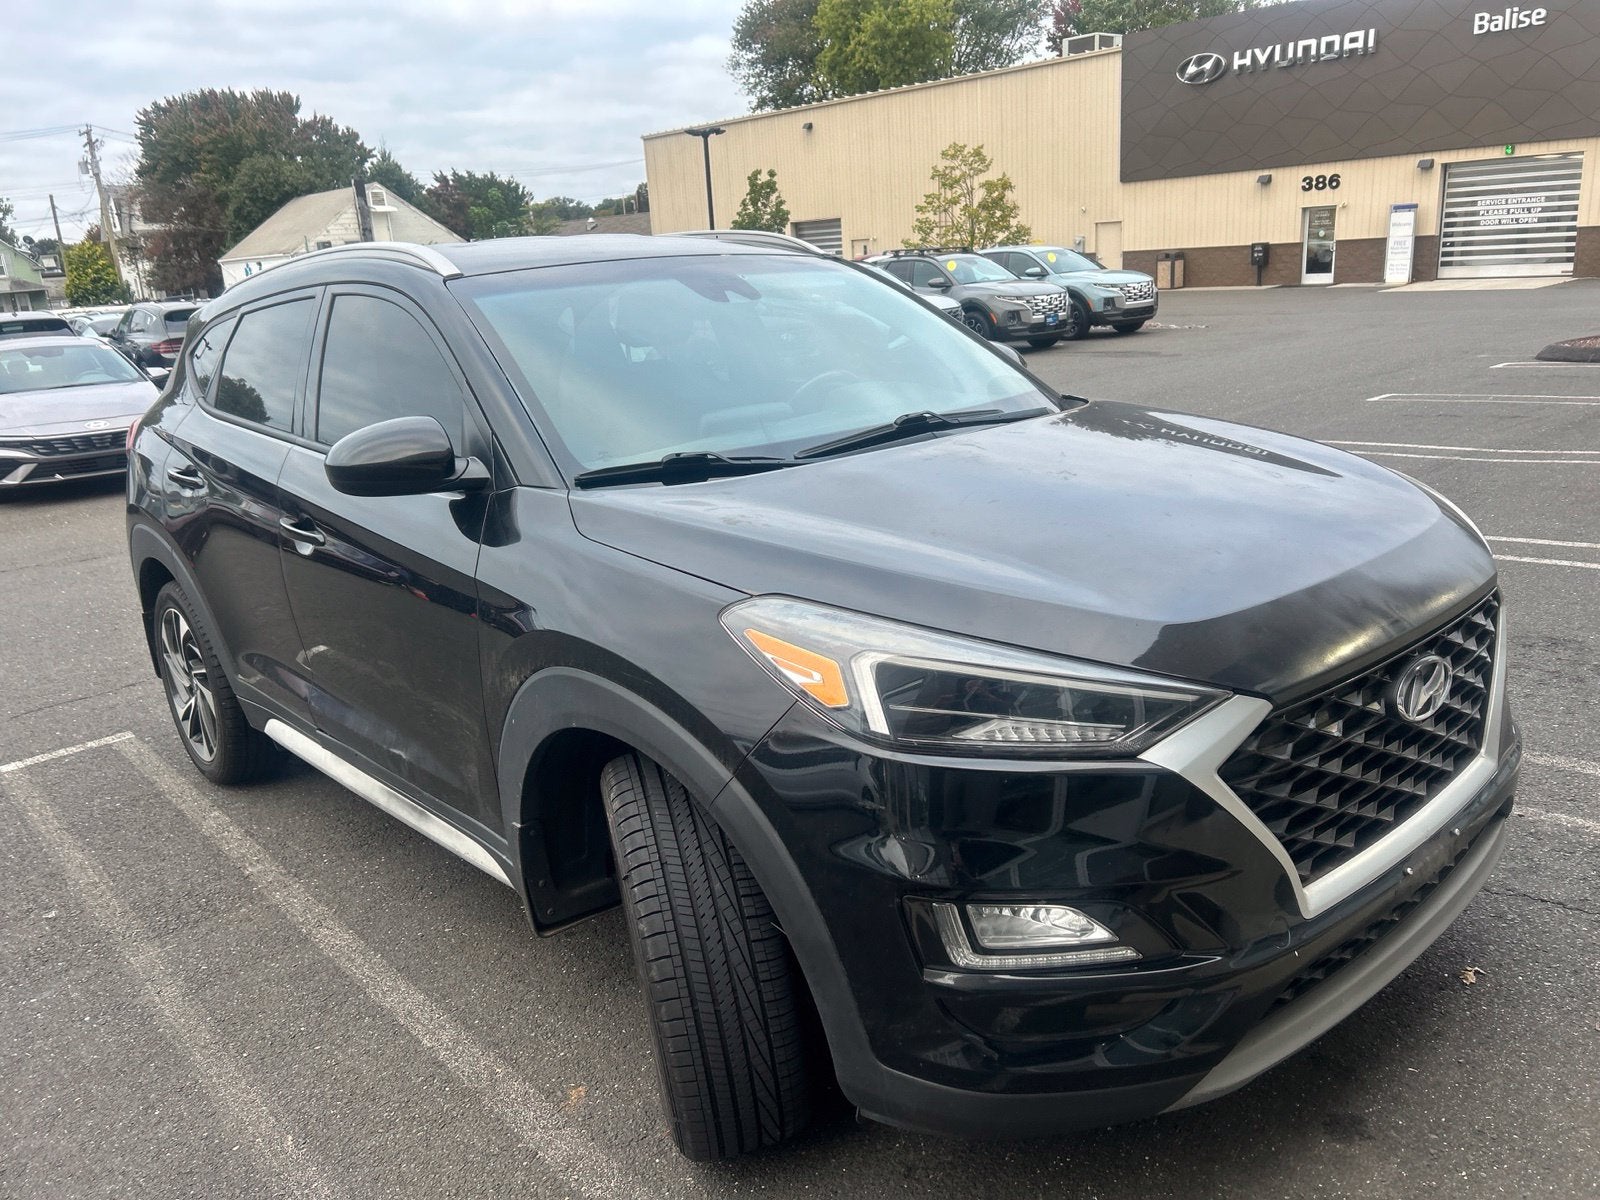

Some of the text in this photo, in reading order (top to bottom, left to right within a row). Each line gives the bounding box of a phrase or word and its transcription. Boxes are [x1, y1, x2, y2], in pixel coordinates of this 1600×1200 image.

[1473, 7, 1547, 35] Balise
[1233, 28, 1376, 72] HYUNDAI
[1301, 173, 1341, 192] 386
[1477, 196, 1546, 206] SERVICE ENTRANCE
[1480, 208, 1508, 216] PLEASE
[1480, 218, 1499, 226] DOOR
